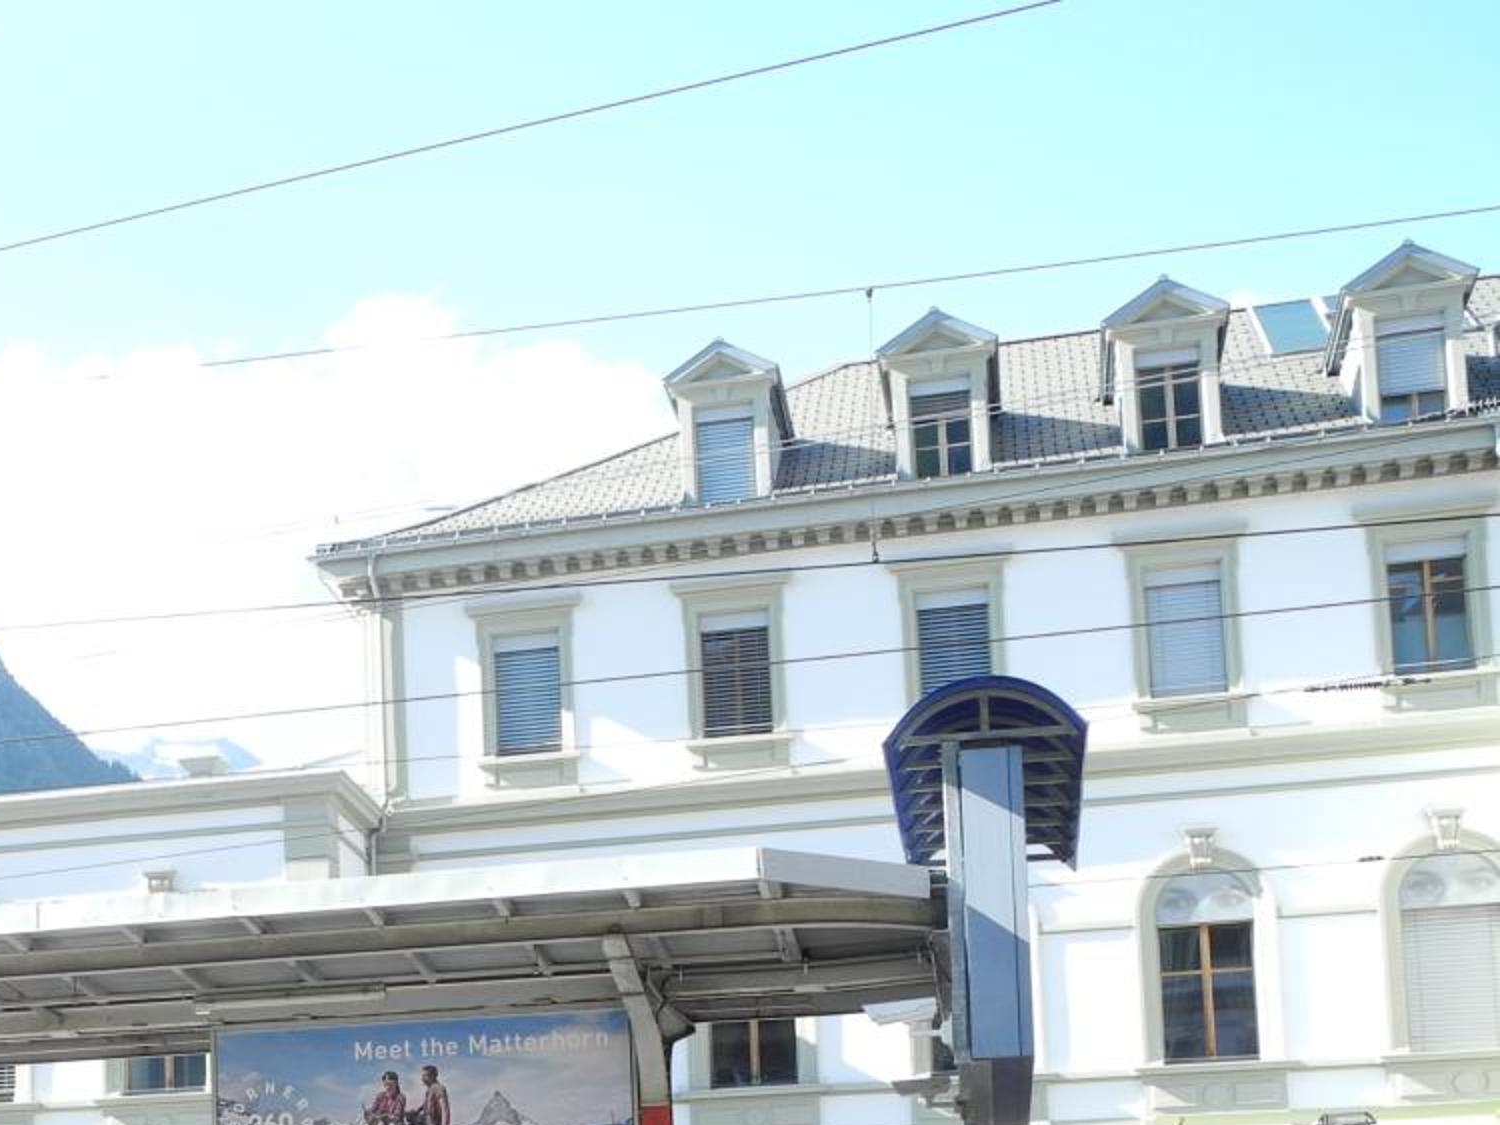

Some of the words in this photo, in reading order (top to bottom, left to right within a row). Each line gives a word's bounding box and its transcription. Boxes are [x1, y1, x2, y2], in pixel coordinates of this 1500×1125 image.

[354, 1041, 411, 1061] Meet
[420, 1037, 459, 1057] the
[469, 1030, 609, 1056] Matterhorn
